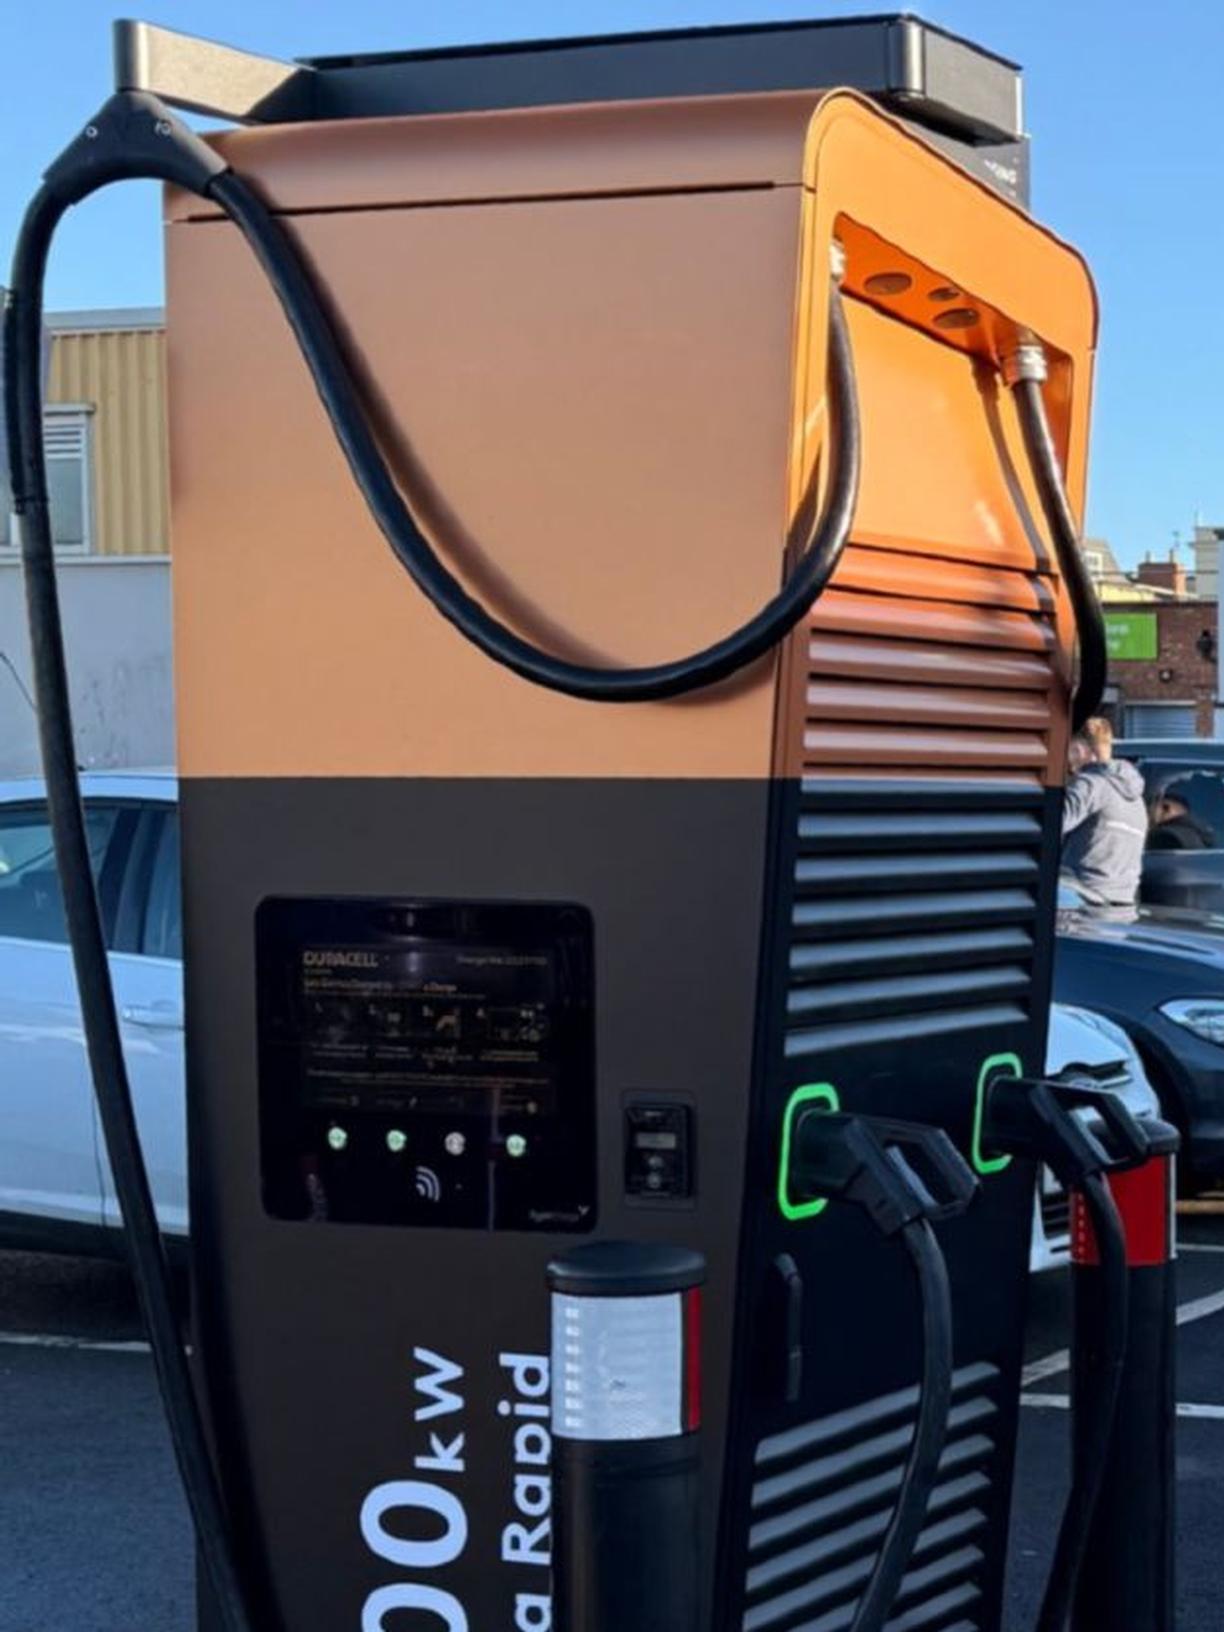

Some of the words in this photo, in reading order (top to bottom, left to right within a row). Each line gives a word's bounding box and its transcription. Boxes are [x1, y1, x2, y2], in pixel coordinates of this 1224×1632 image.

[303, 950, 379, 968] DURACELL
[360, 1346, 468, 1632] 00kW
[498, 1353, 552, 1565] Rapid
